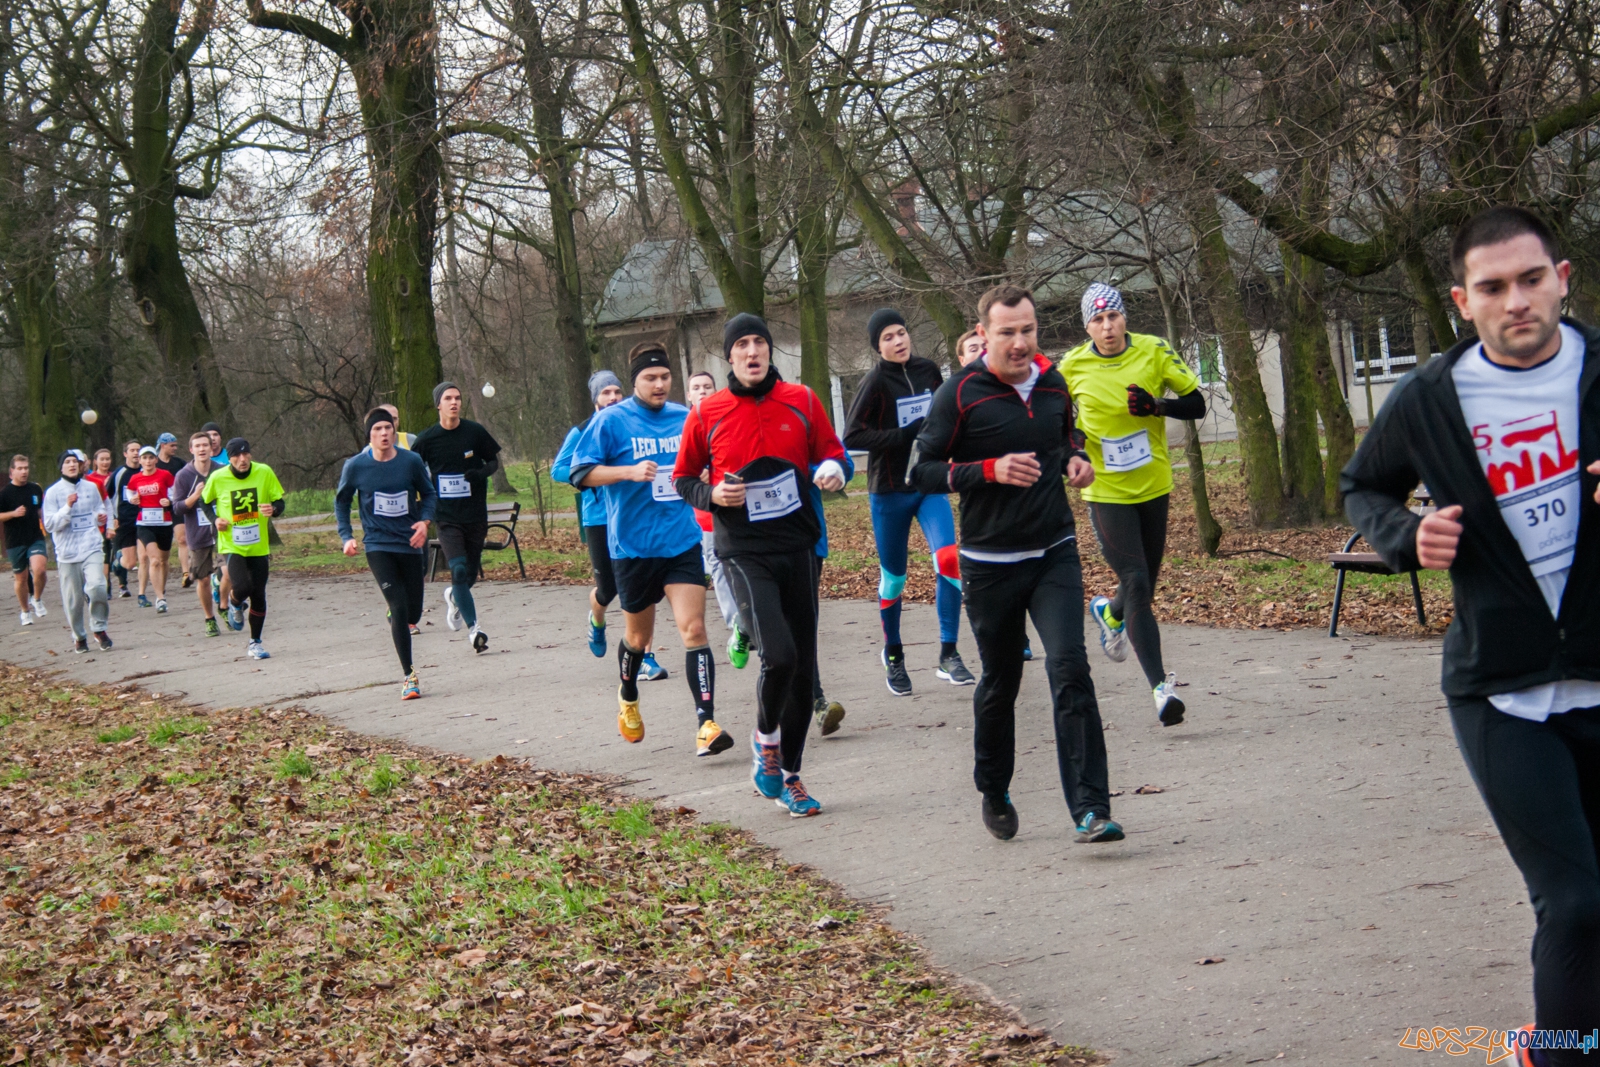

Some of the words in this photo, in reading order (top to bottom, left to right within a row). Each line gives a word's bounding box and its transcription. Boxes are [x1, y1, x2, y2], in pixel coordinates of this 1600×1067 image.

[630, 436, 658, 460] LECH
[1117, 442, 1134, 454] 164
[764, 487, 782, 499] 835
[1523, 498, 1566, 527] 370
